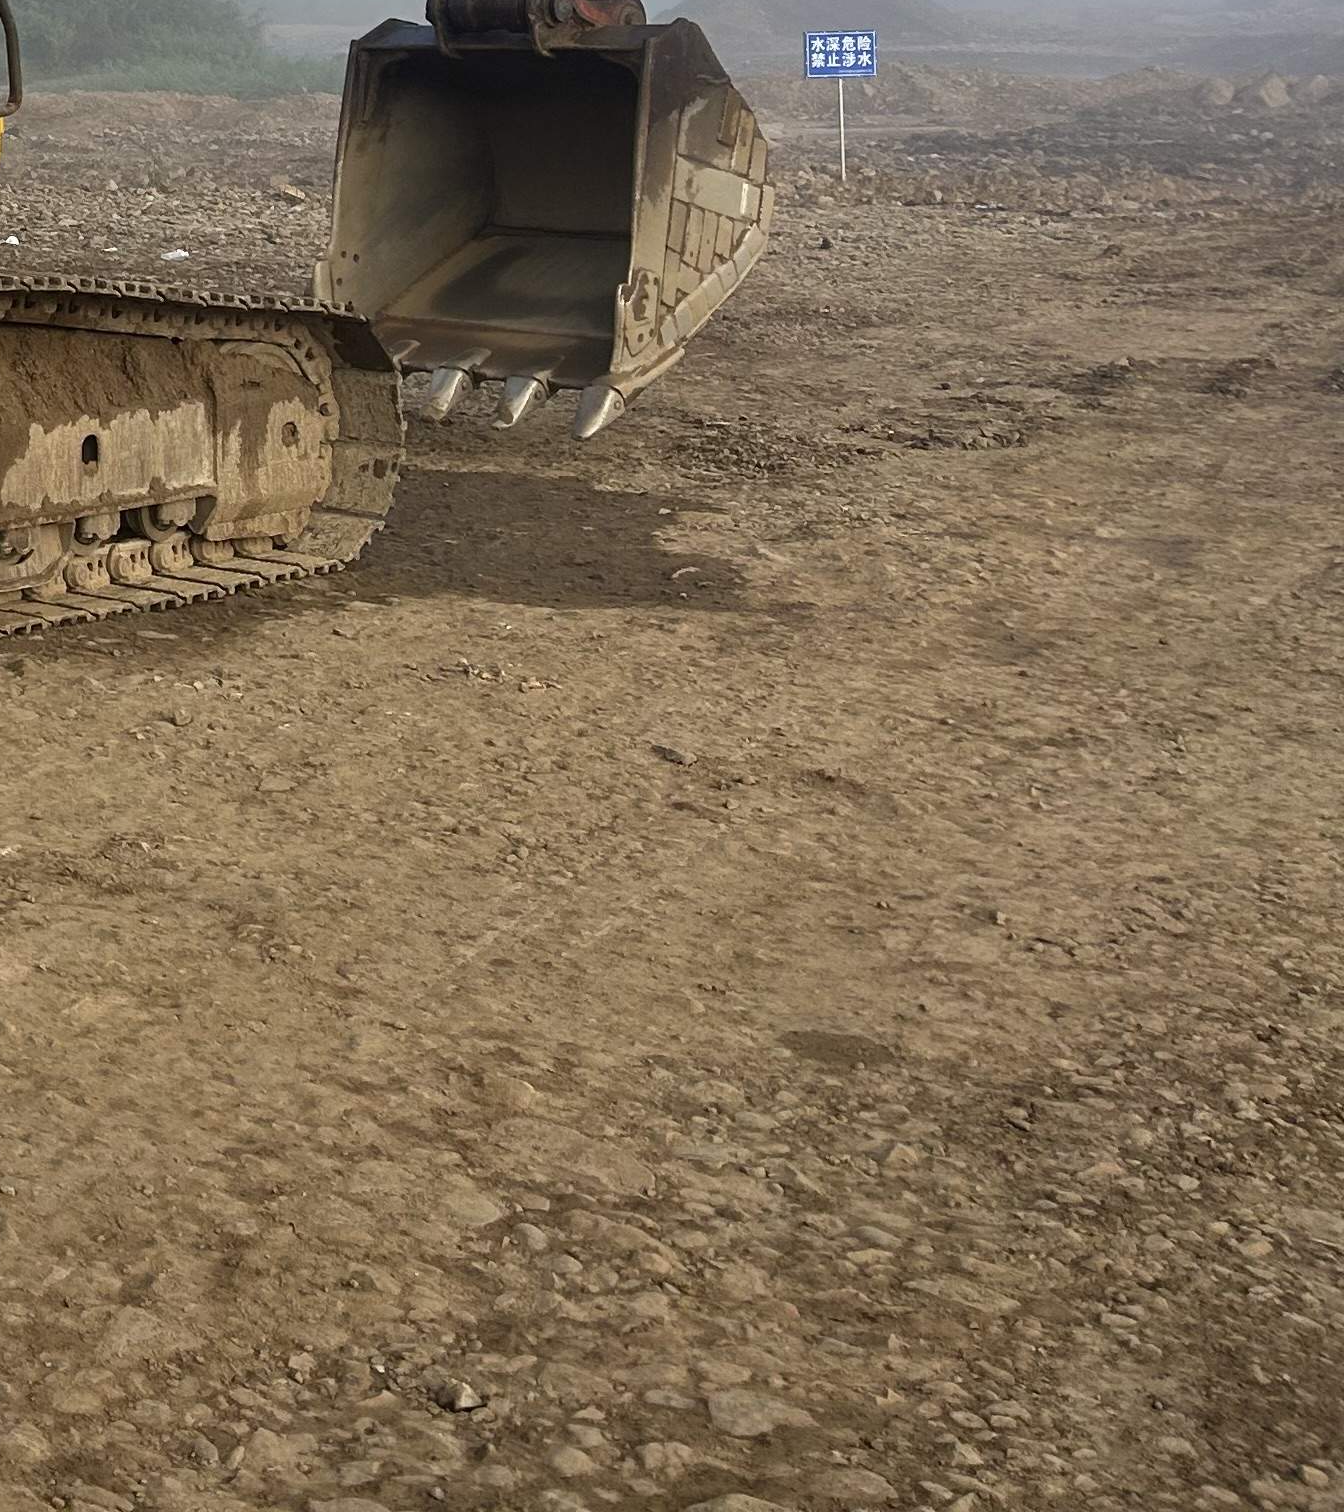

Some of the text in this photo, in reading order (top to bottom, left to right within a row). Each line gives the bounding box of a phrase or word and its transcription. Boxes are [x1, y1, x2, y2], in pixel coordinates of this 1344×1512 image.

[811, 35, 872, 52] 水深危险
[811, 51, 873, 68] 禁止涉水
